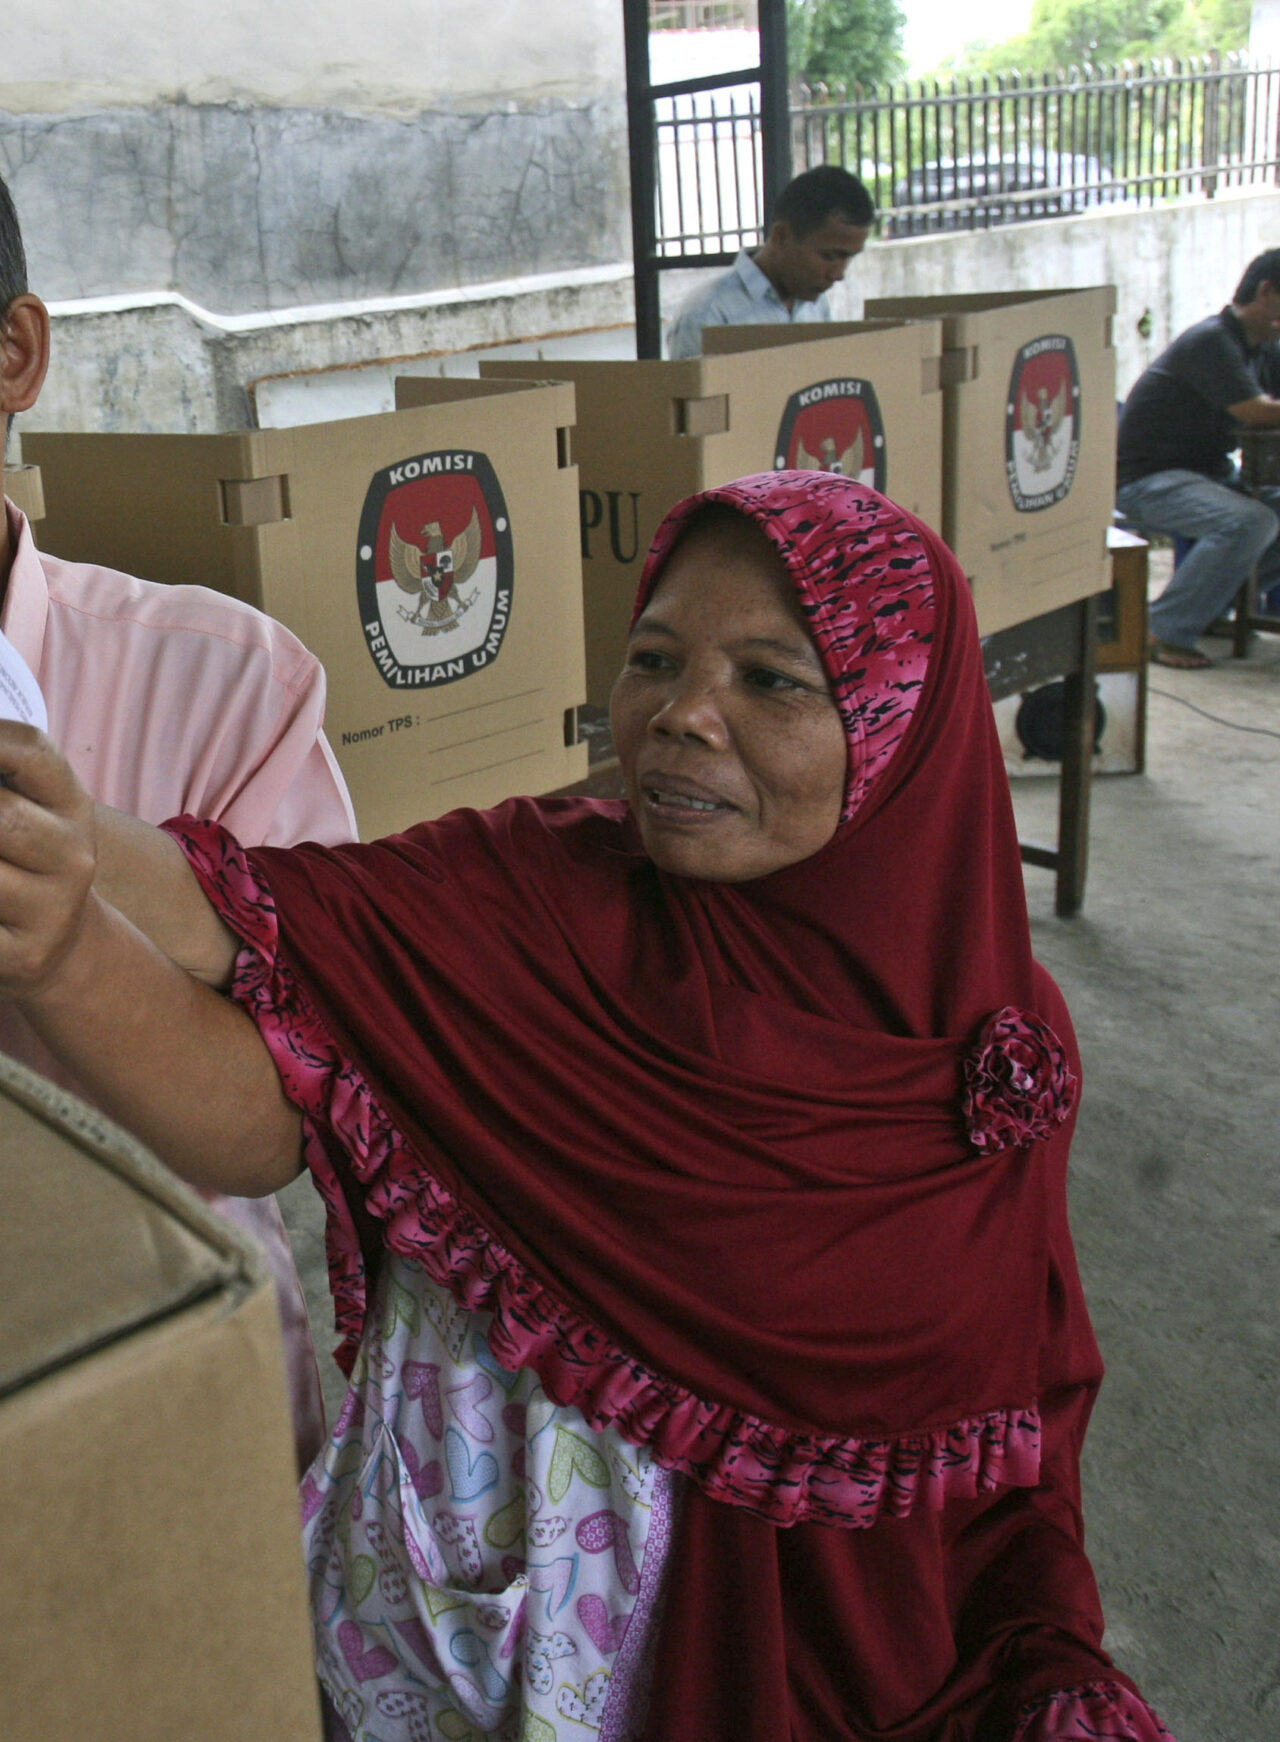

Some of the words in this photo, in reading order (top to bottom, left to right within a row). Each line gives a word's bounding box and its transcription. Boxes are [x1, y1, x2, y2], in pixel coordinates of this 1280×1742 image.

[1023, 338, 1067, 358] KOMISI
[799, 381, 861, 406] KOMISI
[389, 455, 473, 485] KOMISI
[365, 621, 464, 685] PEMILIHAN
[472, 589, 509, 666] UMUM
[342, 726, 385, 746] Nomor
[387, 715, 413, 732] TPS
